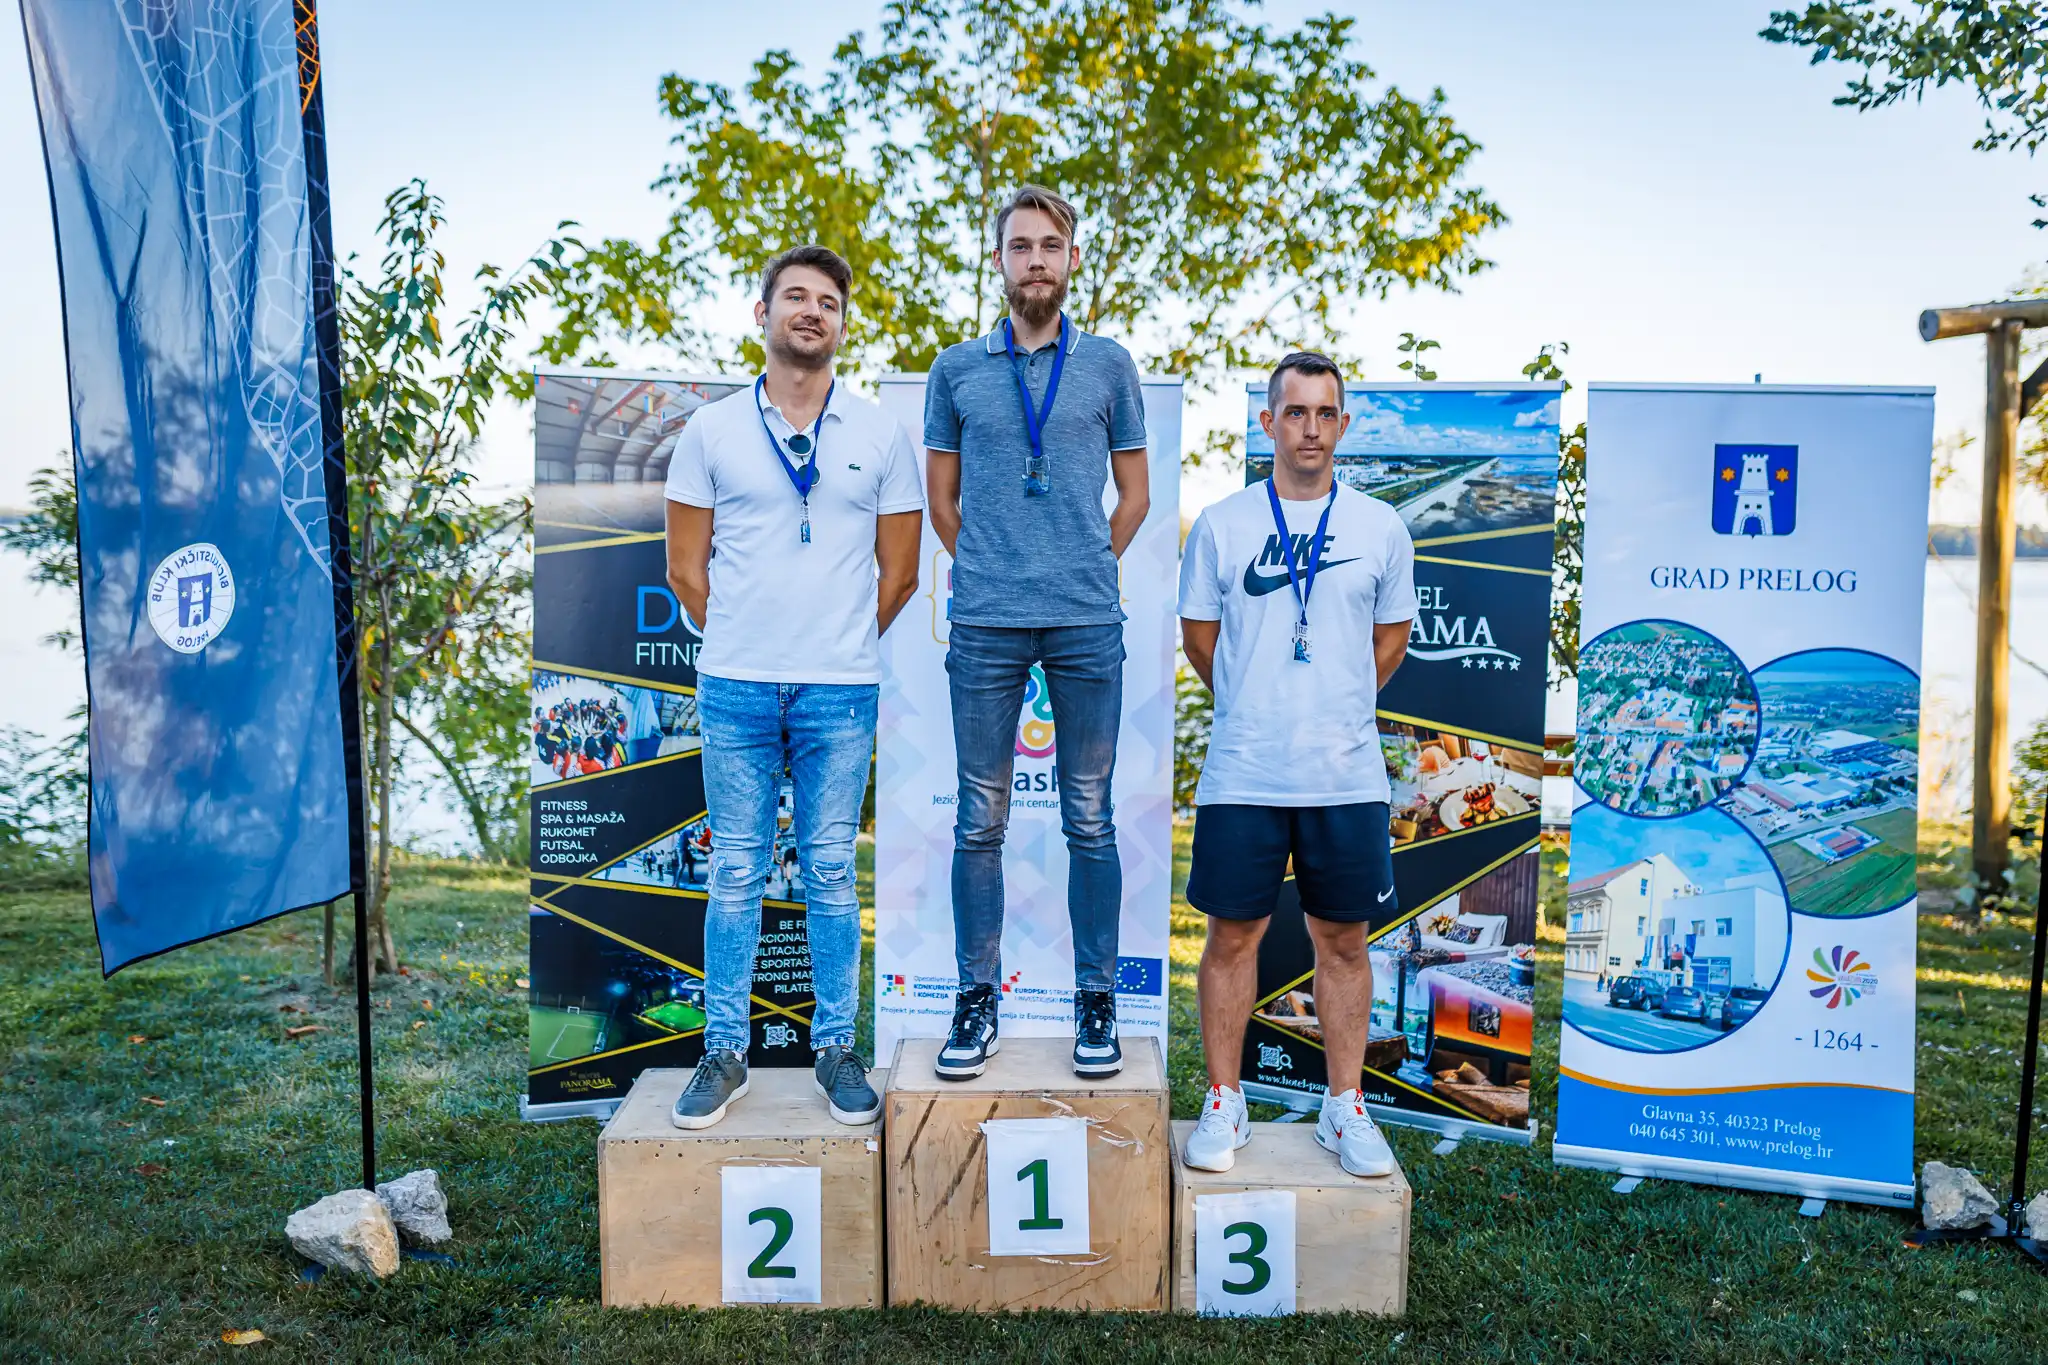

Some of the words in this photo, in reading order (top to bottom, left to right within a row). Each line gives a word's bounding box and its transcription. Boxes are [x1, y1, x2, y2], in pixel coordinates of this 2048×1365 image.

[1258, 533, 1336, 566] NIKE
[1650, 565, 1730, 590] GRAD
[1739, 568, 1858, 593] PRELOG
[1415, 586, 1450, 610] EL
[1408, 614, 1498, 648] AMA
[636, 642, 703, 666] FITNE
[540, 800, 588, 811] FITNESS
[1010, 797, 1025, 807] vni
[1026, 799, 1060, 809] centar
[540, 813, 563, 825] SPA
[565, 814, 574, 824] &
[576, 811, 626, 824] MASAŽA
[540, 826, 597, 838] RUKOMET
[540, 840, 585, 851] FUTSAL
[540, 853, 599, 864] ODBOJKA
[779, 920, 794, 930] BE
[796, 920, 806, 930] FI
[760, 932, 807, 944] KCIONAL
[757, 945, 810, 957] ILITACIJS
[760, 956, 811, 970] SPORTAŠ
[751, 971, 790, 983] TRONG
[913, 983, 960, 991] KONKURENTN
[880, 1006, 908, 1015] Projekt
[917, 1007, 955, 1016] sufinancir
[1812, 1029, 1864, 1052] 1264
[560, 1078, 613, 1089] PANORAMA
[1642, 1104, 1694, 1124] Glavna
[1698, 1110, 1720, 1128] 35,
[1724, 1113, 1769, 1132] 40323
[1774, 1118, 1822, 1141] Prelog
[1629, 1122, 1656, 1139] 040
[1660, 1125, 1686, 1142] 645
[1690, 1129, 1721, 1149] 301,
[1725, 1135, 1834, 1160] www.prelog.hr
[1017, 1158, 1064, 1231] 1
[747, 1206, 797, 1279] 2
[1222, 1221, 1272, 1295] 3
